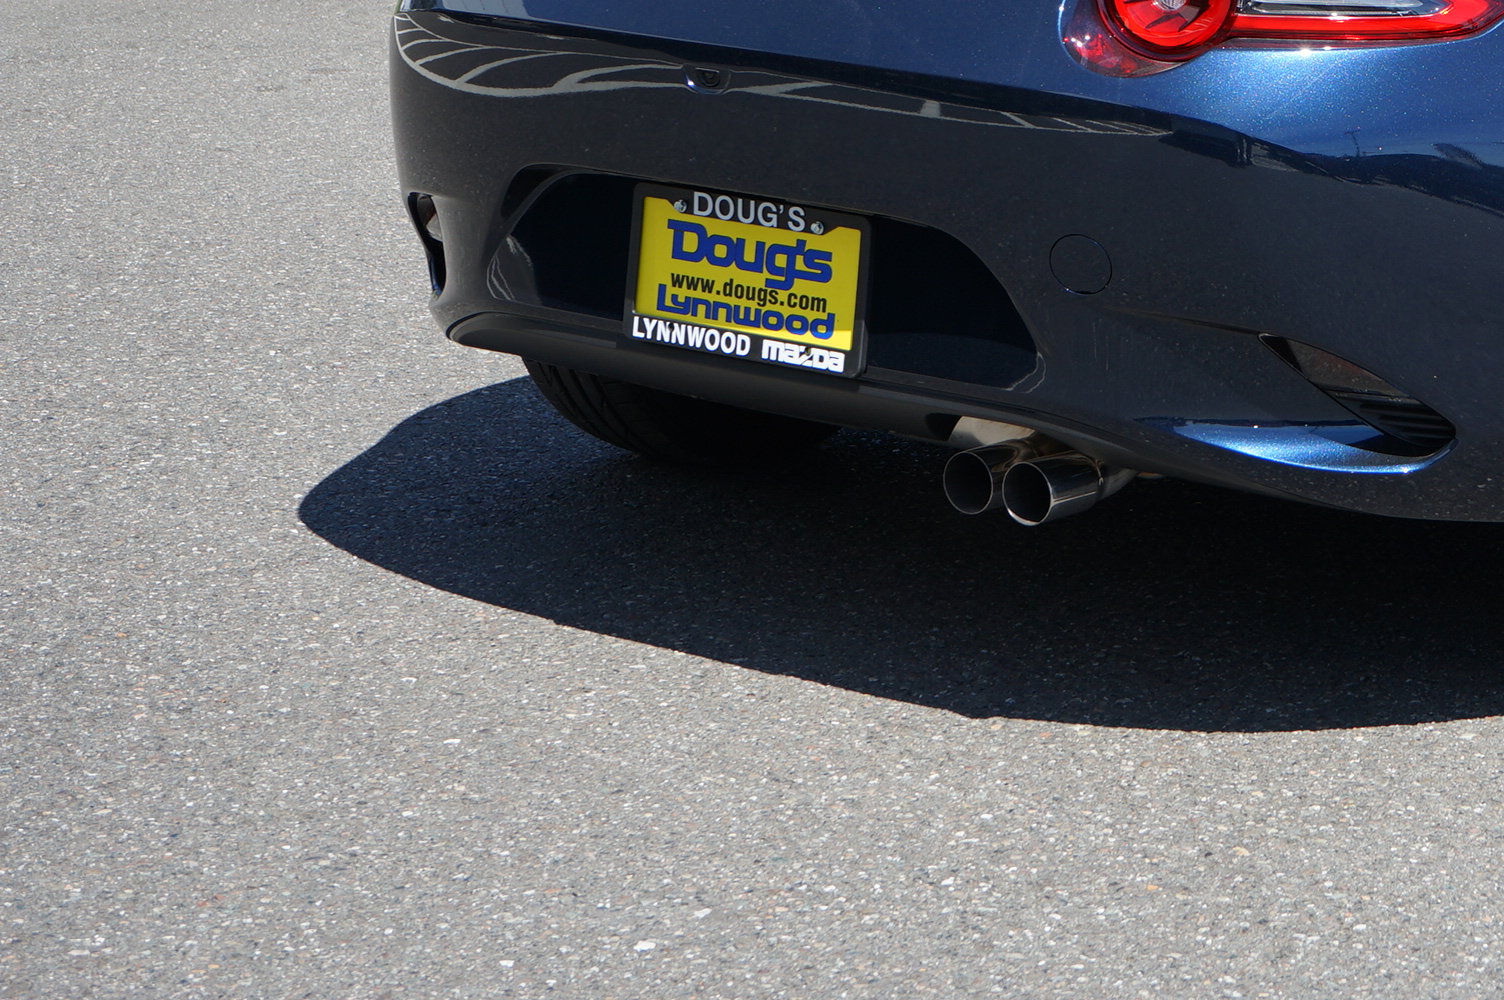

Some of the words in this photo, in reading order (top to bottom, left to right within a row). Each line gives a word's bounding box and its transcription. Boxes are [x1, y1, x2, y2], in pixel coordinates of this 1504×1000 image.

[693, 191, 806, 232] DOUG'S
[656, 283, 836, 340] Lynnwood
[670, 272, 828, 313] www.dougs.com
[632, 316, 751, 356] LYNNWOOD
